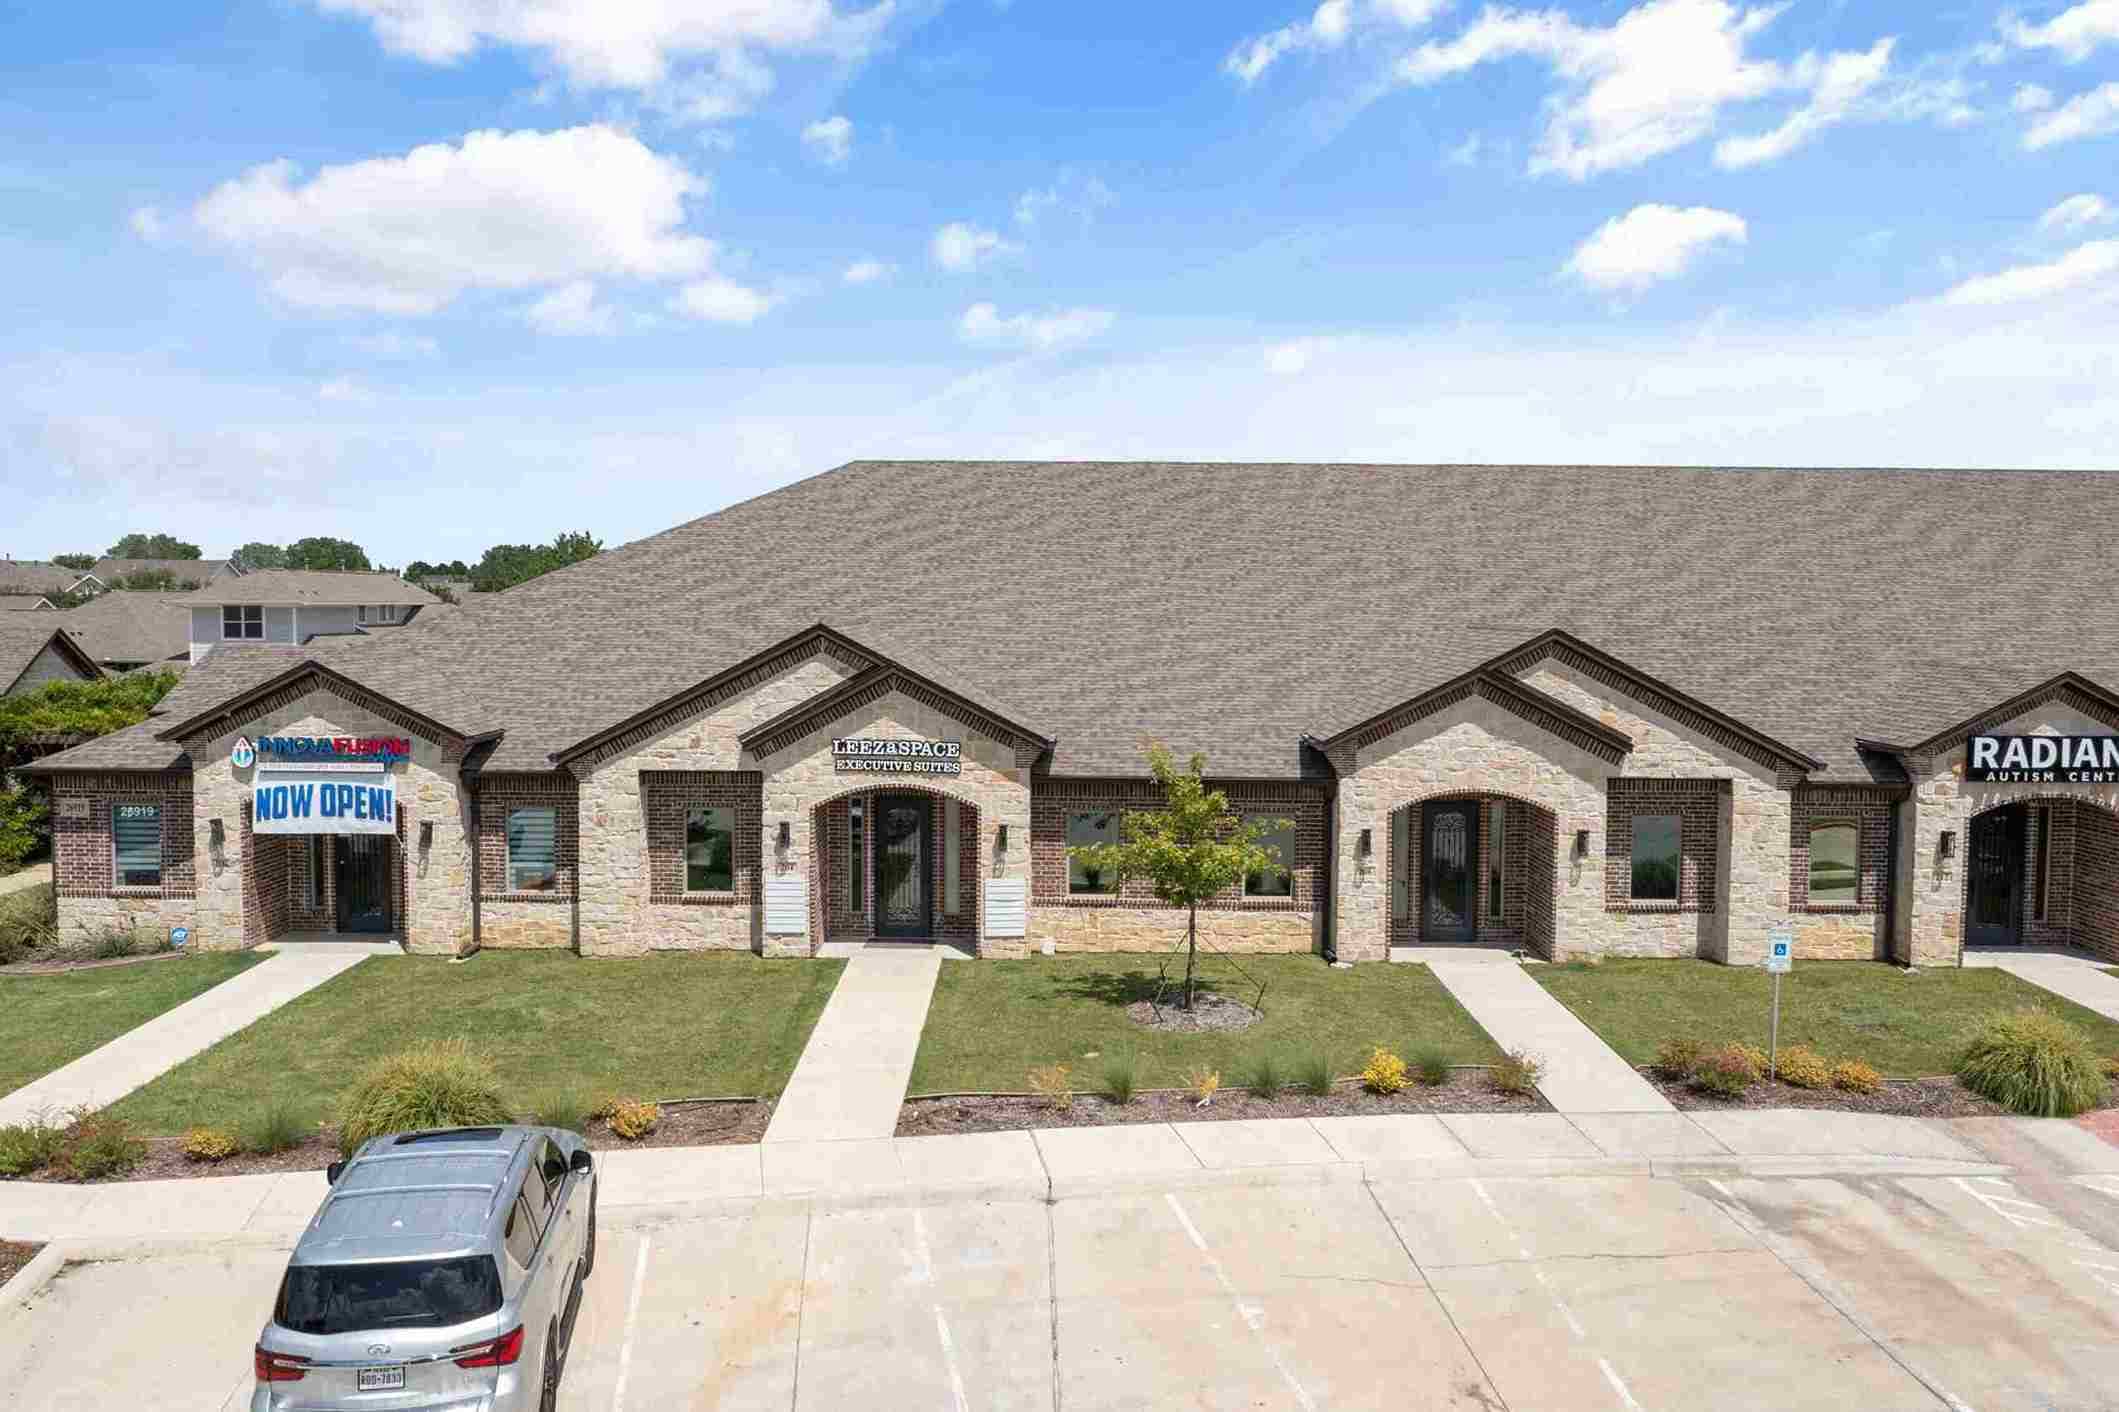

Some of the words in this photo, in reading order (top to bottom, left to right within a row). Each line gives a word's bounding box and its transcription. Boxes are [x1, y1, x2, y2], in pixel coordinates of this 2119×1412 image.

[836, 759, 912, 771] EXECUTIVE
[913, 761, 960, 773] SUITES
[1986, 771, 2055, 782] AUTISM
[256, 783, 314, 822] NOW
[320, 783, 393, 823] OPEN!
